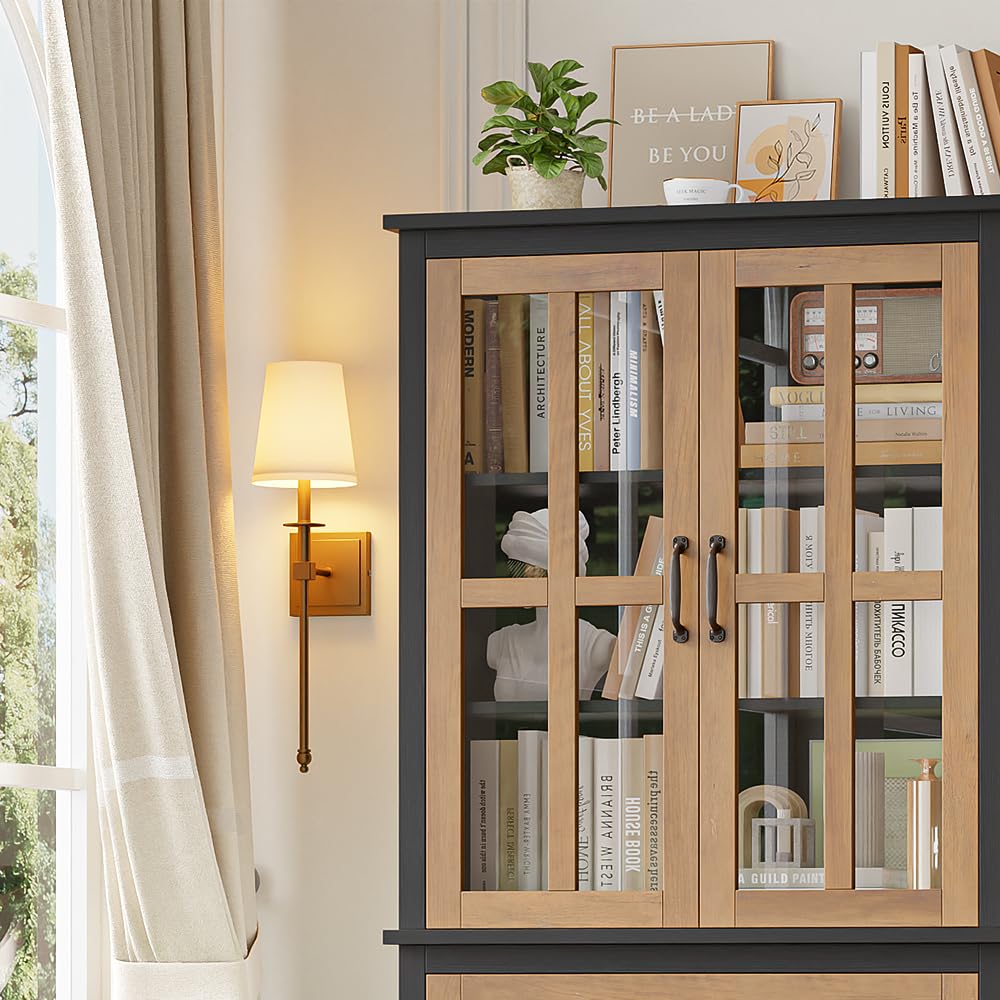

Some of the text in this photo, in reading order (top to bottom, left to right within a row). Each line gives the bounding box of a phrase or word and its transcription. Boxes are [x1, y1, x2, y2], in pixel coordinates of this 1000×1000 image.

[634, 104, 737, 124] BE A LAD
[649, 145, 727, 164] BE YOU
[464, 310, 474, 378] MODERN
[536, 327, 546, 419] ARCHITECTURE
[579, 303, 592, 452] ALL ABOUT YVES
[629, 349, 638, 418] MINIMALISM
[612, 372, 624, 454] Peter Lindbergh
[886, 406, 937, 417] LIVING
[634, 633, 646, 653] THIS
[639, 623, 649, 632] IS
[873, 601, 882, 684] ОХИТИТЕЛЬ БАБОЧЕК
[891, 604, 906, 658] ПИКАССО
[751, 873, 788, 884] GUILD
